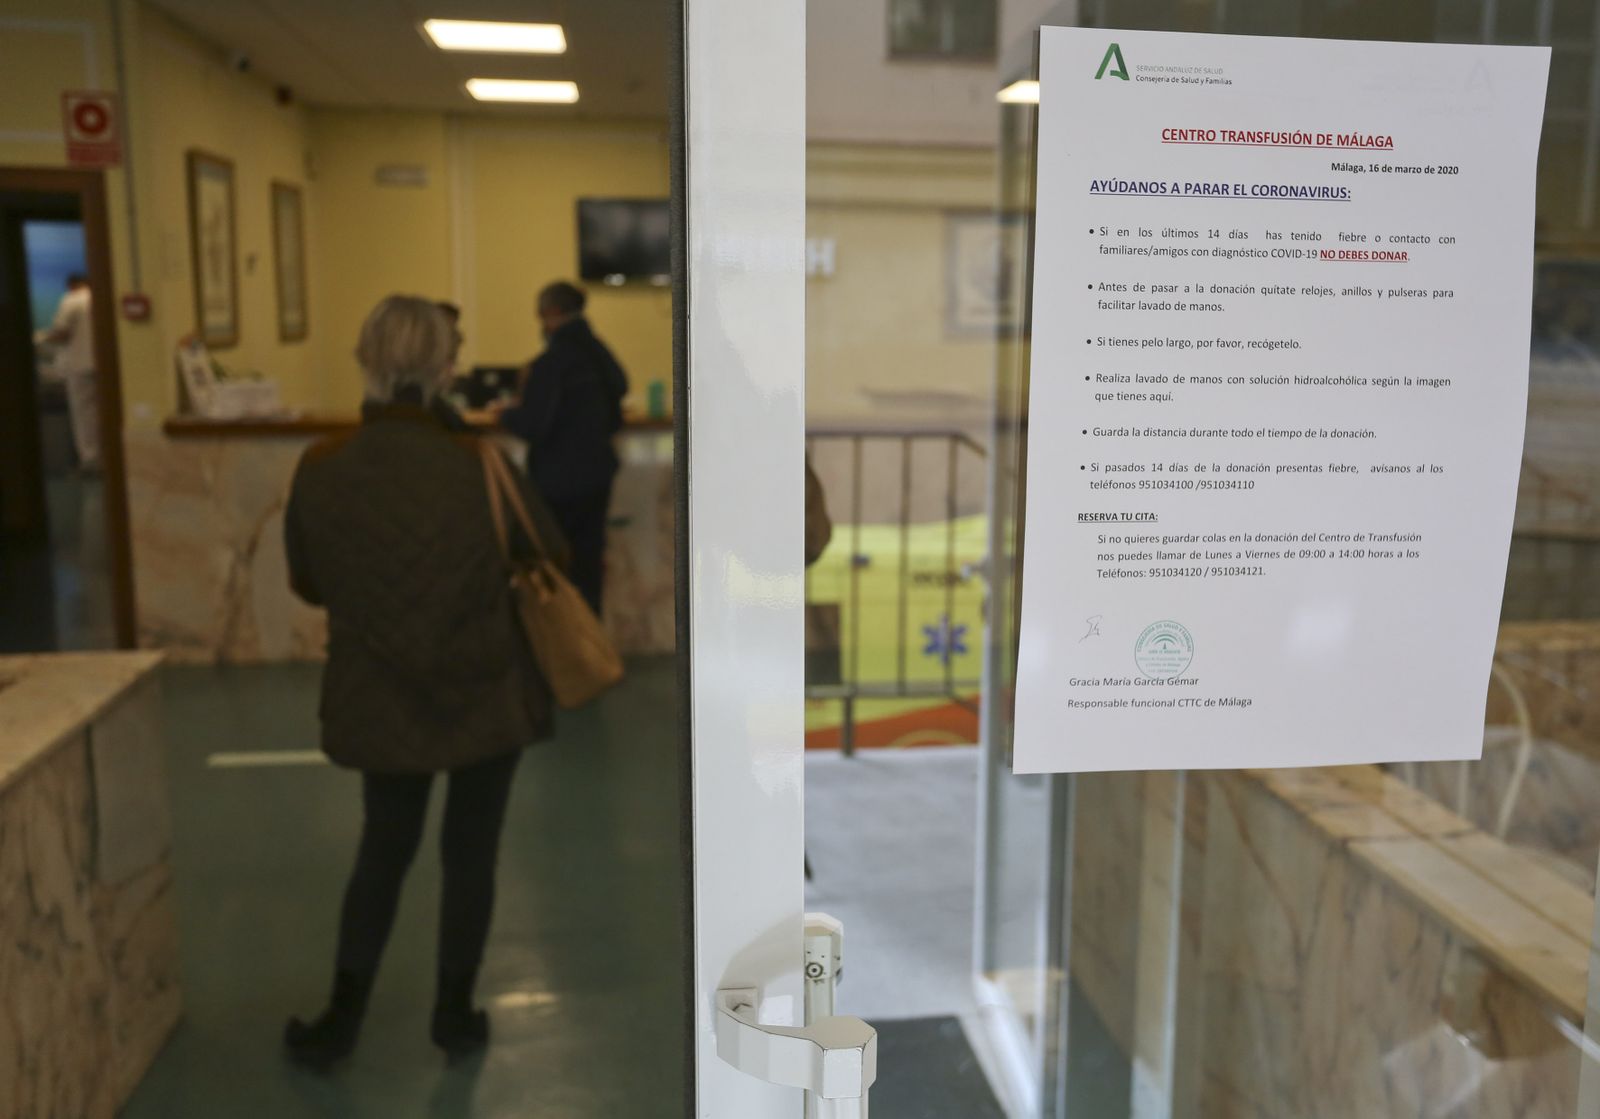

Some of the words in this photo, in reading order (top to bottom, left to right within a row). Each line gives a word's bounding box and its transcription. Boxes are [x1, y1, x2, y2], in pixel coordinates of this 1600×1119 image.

[1135, 64, 1165, 73] SERVICIO
[1164, 65, 1193, 74] ANDALUZ
[1193, 66, 1202, 74] DE
[1202, 66, 1224, 76] SALUD
[1180, 75, 1200, 84] Salud
[1200, 78, 1205, 86] y
[1161, 128, 1216, 142] CENTRO
[1220, 129, 1312, 145] TRANSFUSIÓN
[1316, 133, 1333, 146] DE
[1336, 132, 1394, 148] MÁLAGA
[1330, 162, 1366, 174] Málaga,
[1368, 163, 1380, 173] 16
[1381, 163, 1393, 174] de
[1394, 166, 1422, 174] marzo
[1423, 164, 1435, 175] de
[1437, 165, 1459, 175] 2020
[1089, 178, 1167, 194] AYÚDANOS
[1170, 181, 1181, 194] A
[1184, 182, 1230, 195] PARAR
[1233, 183, 1248, 196] EL
[1251, 184, 1352, 199] CORONAVIRUS:
[1099, 226, 1108, 237] Si
[1116, 228, 1130, 237] en
[1138, 226, 1153, 238] los
[1161, 227, 1199, 239] últimos
[1207, 228, 1220, 239] 14
[1228, 228, 1249, 240] días
[1265, 229, 1282, 240] has
[1290, 230, 1322, 241] tenido
[1338, 231, 1367, 243] fiebre
[1374, 234, 1381, 243] o
[1388, 234, 1431, 244] contacto
[1438, 236, 1456, 245] con
[1099, 243, 1189, 259] familiares/amigos
[1190, 248, 1209, 257] con
[1211, 246, 1269, 260] diagnóstico
[1270, 248, 1318, 259] COVID-19
[1320, 249, 1336, 259] NO
[1338, 250, 1369, 260] DEBES
[1371, 250, 1411, 261] DONAR.
[1097, 281, 1127, 292] Antes
[1132, 281, 1146, 293] de
[1151, 284, 1179, 295] pasar
[1183, 285, 1190, 293] a
[1195, 283, 1204, 293] la
[1209, 283, 1255, 294] donación
[1260, 284, 1296, 297] quítate
[1301, 284, 1336, 298] relojes,
[1341, 285, 1372, 297] anillos
[1377, 289, 1383, 299] y
[1387, 287, 1428, 299] pulseras
[1432, 289, 1454, 300] para
[1097, 299, 1136, 310] facilitar
[1138, 300, 1172, 311] lavado
[1173, 300, 1187, 311] de
[1189, 303, 1225, 312] manos.
[1096, 336, 1106, 347] Si
[1108, 336, 1139, 347] tienes
[1141, 336, 1164, 349] pelo
[1165, 337, 1194, 350] largo,
[1196, 339, 1214, 350] por
[1216, 337, 1244, 349] favor,
[1247, 338, 1302, 351] recógetelo.
[1095, 372, 1131, 383] Realiza
[1135, 373, 1169, 384] lavado
[1172, 373, 1186, 384] de
[1189, 376, 1223, 384] manos
[1226, 376, 1245, 385] con
[1249, 374, 1290, 385] solución
[1294, 374, 1367, 386] hidroalcohólica
[1371, 375, 1400, 388] según
[1403, 375, 1412, 386] la
[1416, 376, 1451, 388] imagen
[1094, 392, 1114, 403] que
[1116, 391, 1147, 401] tienes
[1149, 391, 1174, 403] aquí.
[1092, 426, 1129, 437] Guarda
[1131, 426, 1141, 437] la
[1143, 427, 1187, 437] distancia
[1189, 427, 1229, 438] durante
[1230, 427, 1254, 438] todo
[1256, 427, 1265, 438] el
[1267, 428, 1302, 440] tiempo
[1304, 428, 1317, 438] de
[1319, 428, 1328, 438] la
[1330, 428, 1377, 439] donación.
[1090, 462, 1099, 472] Si
[1104, 462, 1145, 474] pasados
[1151, 462, 1163, 472] 14
[1168, 462, 1189, 472] días
[1193, 462, 1207, 472] de
[1211, 462, 1221, 473] la
[1226, 462, 1271, 473] donación
[1275, 463, 1323, 475] presentas
[1328, 463, 1359, 474] fiebre,
[1415, 463, 1425, 473] al
[1430, 463, 1444, 474] los
[1089, 479, 1136, 490] teléfonos
[1138, 479, 1194, 490] 951034100
[1195, 479, 1256, 491] /951034110
[1077, 512, 1118, 522] RESERVA
[1120, 512, 1133, 522] TU
[1134, 512, 1158, 522] CITA:
[1097, 534, 1106, 544] Si
[1108, 536, 1122, 544] no
[1124, 534, 1160, 545] quieres
[1161, 532, 1200, 545] guardar
[1202, 532, 1226, 543] colas
[1243, 532, 1252, 542] la
[1254, 532, 1299, 543] donación
[1301, 532, 1316, 542] del
[1318, 532, 1351, 542] Centro
[1352, 532, 1365, 542] de
[1368, 532, 1422, 542] Transfusión
[1097, 553, 1115, 561] nos
[1117, 551, 1153, 563] puedes
[1156, 550, 1186, 560] llamar
[1189, 550, 1202, 560] de
[1205, 549, 1232, 560] Lunes
[1235, 551, 1241, 559] a
[1244, 549, 1280, 559] Viernes
[1283, 549, 1296, 559] de
[1298, 548, 1326, 559] 09:00
[1338, 548, 1365, 558] 14:00
[1367, 548, 1394, 559] horas
[1406, 548, 1420, 558] los
[1096, 567, 1147, 579] Teléfonos:
[1148, 567, 1202, 578] 951034120
[1203, 566, 1210, 578] /
[1210, 565, 1266, 576] 951034121.
[1069, 677, 1100, 686] Gracia
[1102, 677, 1131, 686] María
[1133, 677, 1164, 686] García
[1166, 676, 1199, 686] Gémar
[1067, 698, 1128, 710] Responsable
[1130, 697, 1176, 708] funcional
[1177, 698, 1202, 708] CTTC
[1203, 697, 1216, 707] de
[1218, 696, 1252, 709] Málaga
